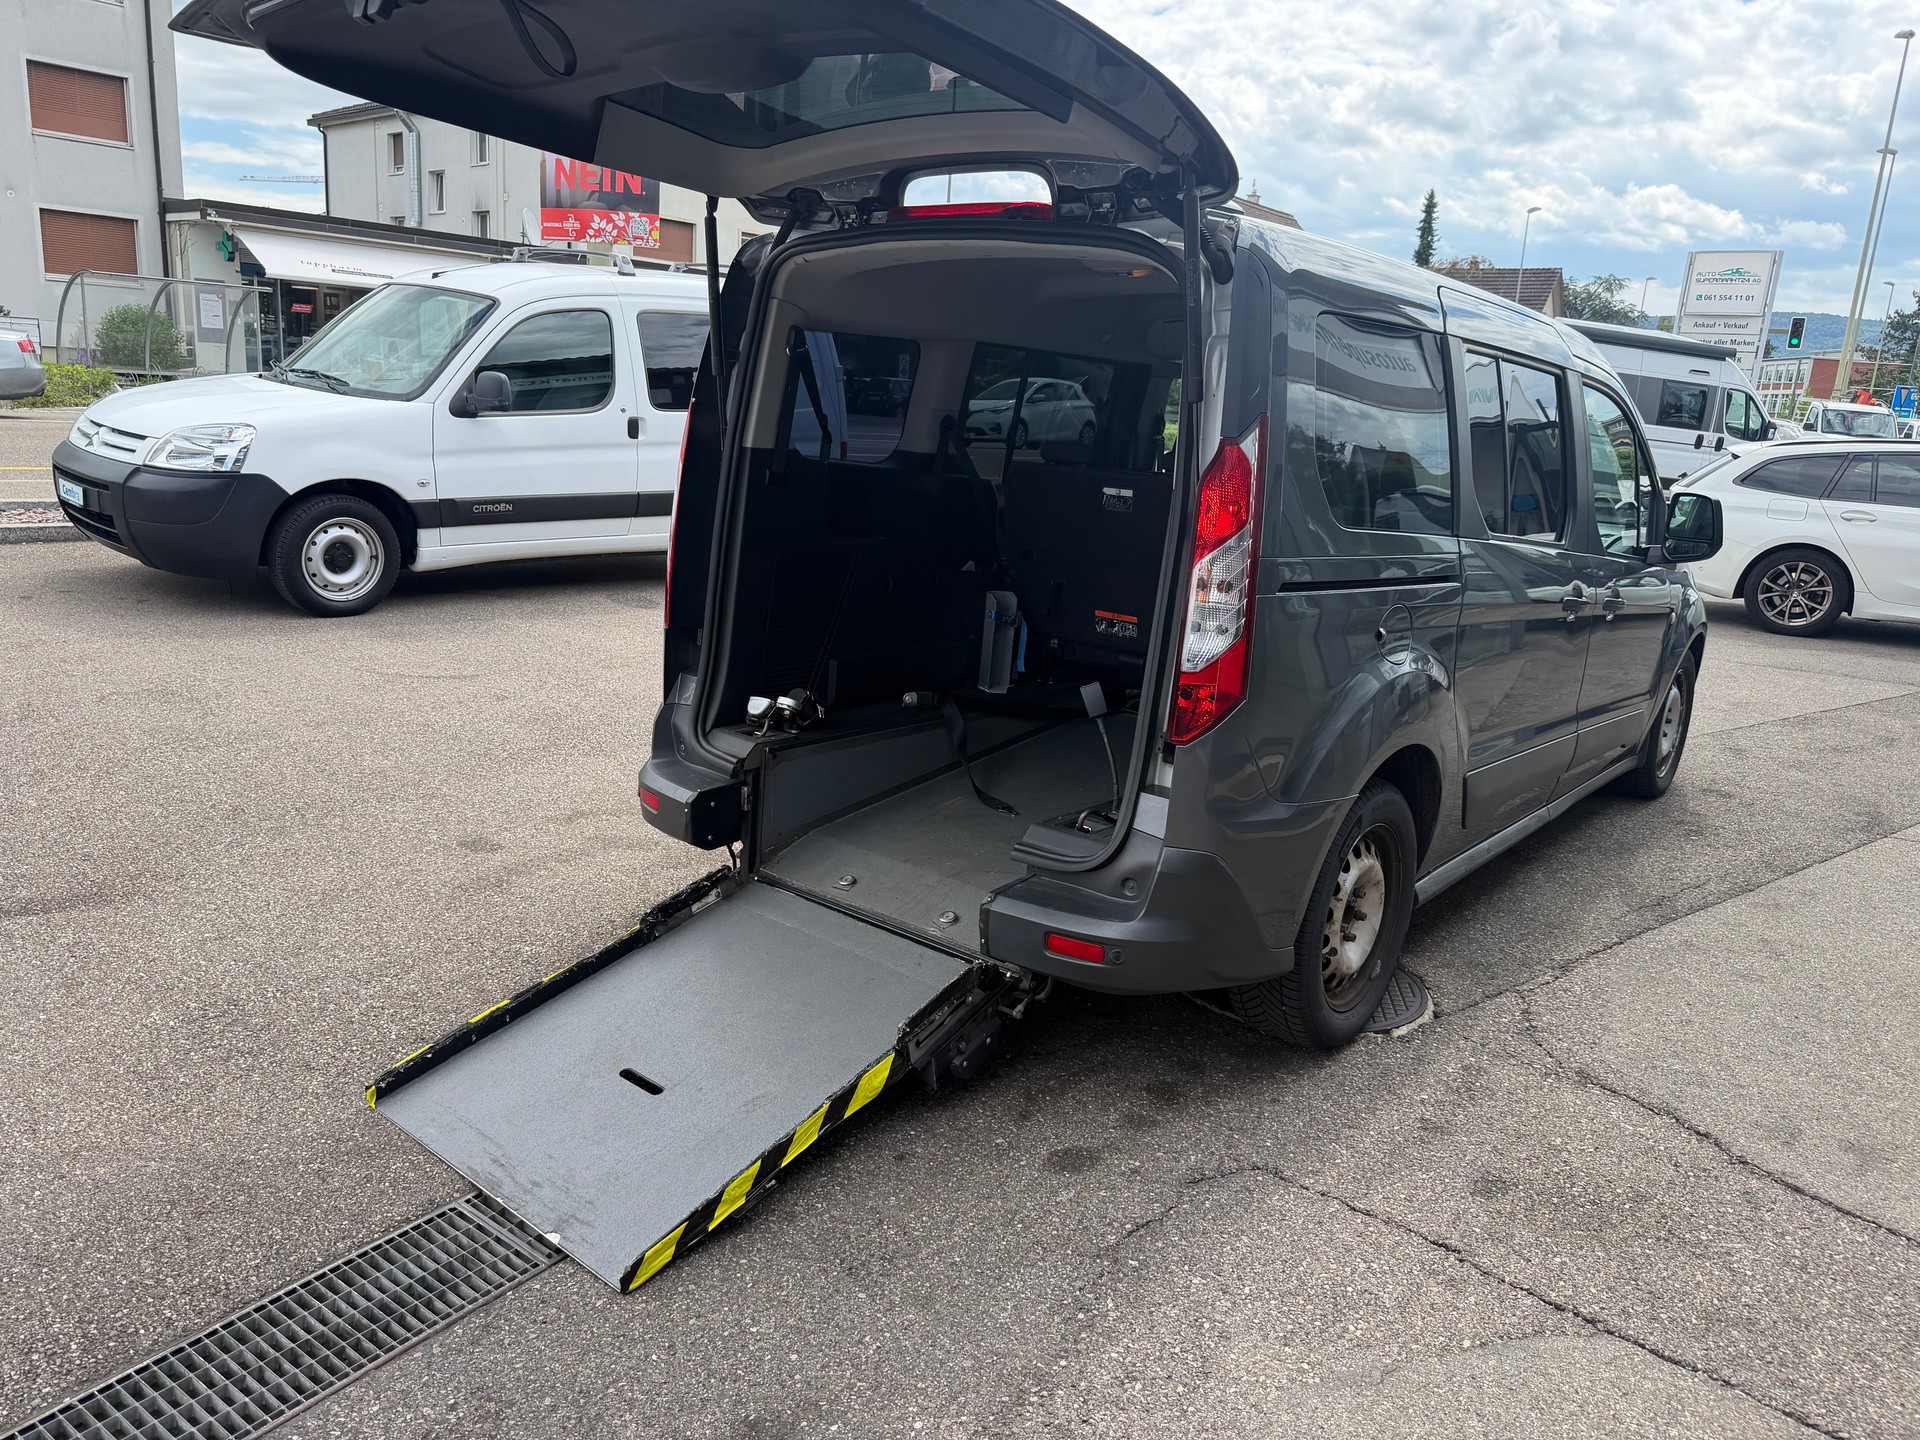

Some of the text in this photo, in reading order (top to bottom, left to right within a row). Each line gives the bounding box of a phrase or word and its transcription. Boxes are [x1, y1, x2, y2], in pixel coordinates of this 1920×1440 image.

[1729, 339, 1756, 347] Marken
[62, 484, 80, 501] Cembra
[472, 502, 513, 513] CITROËN
